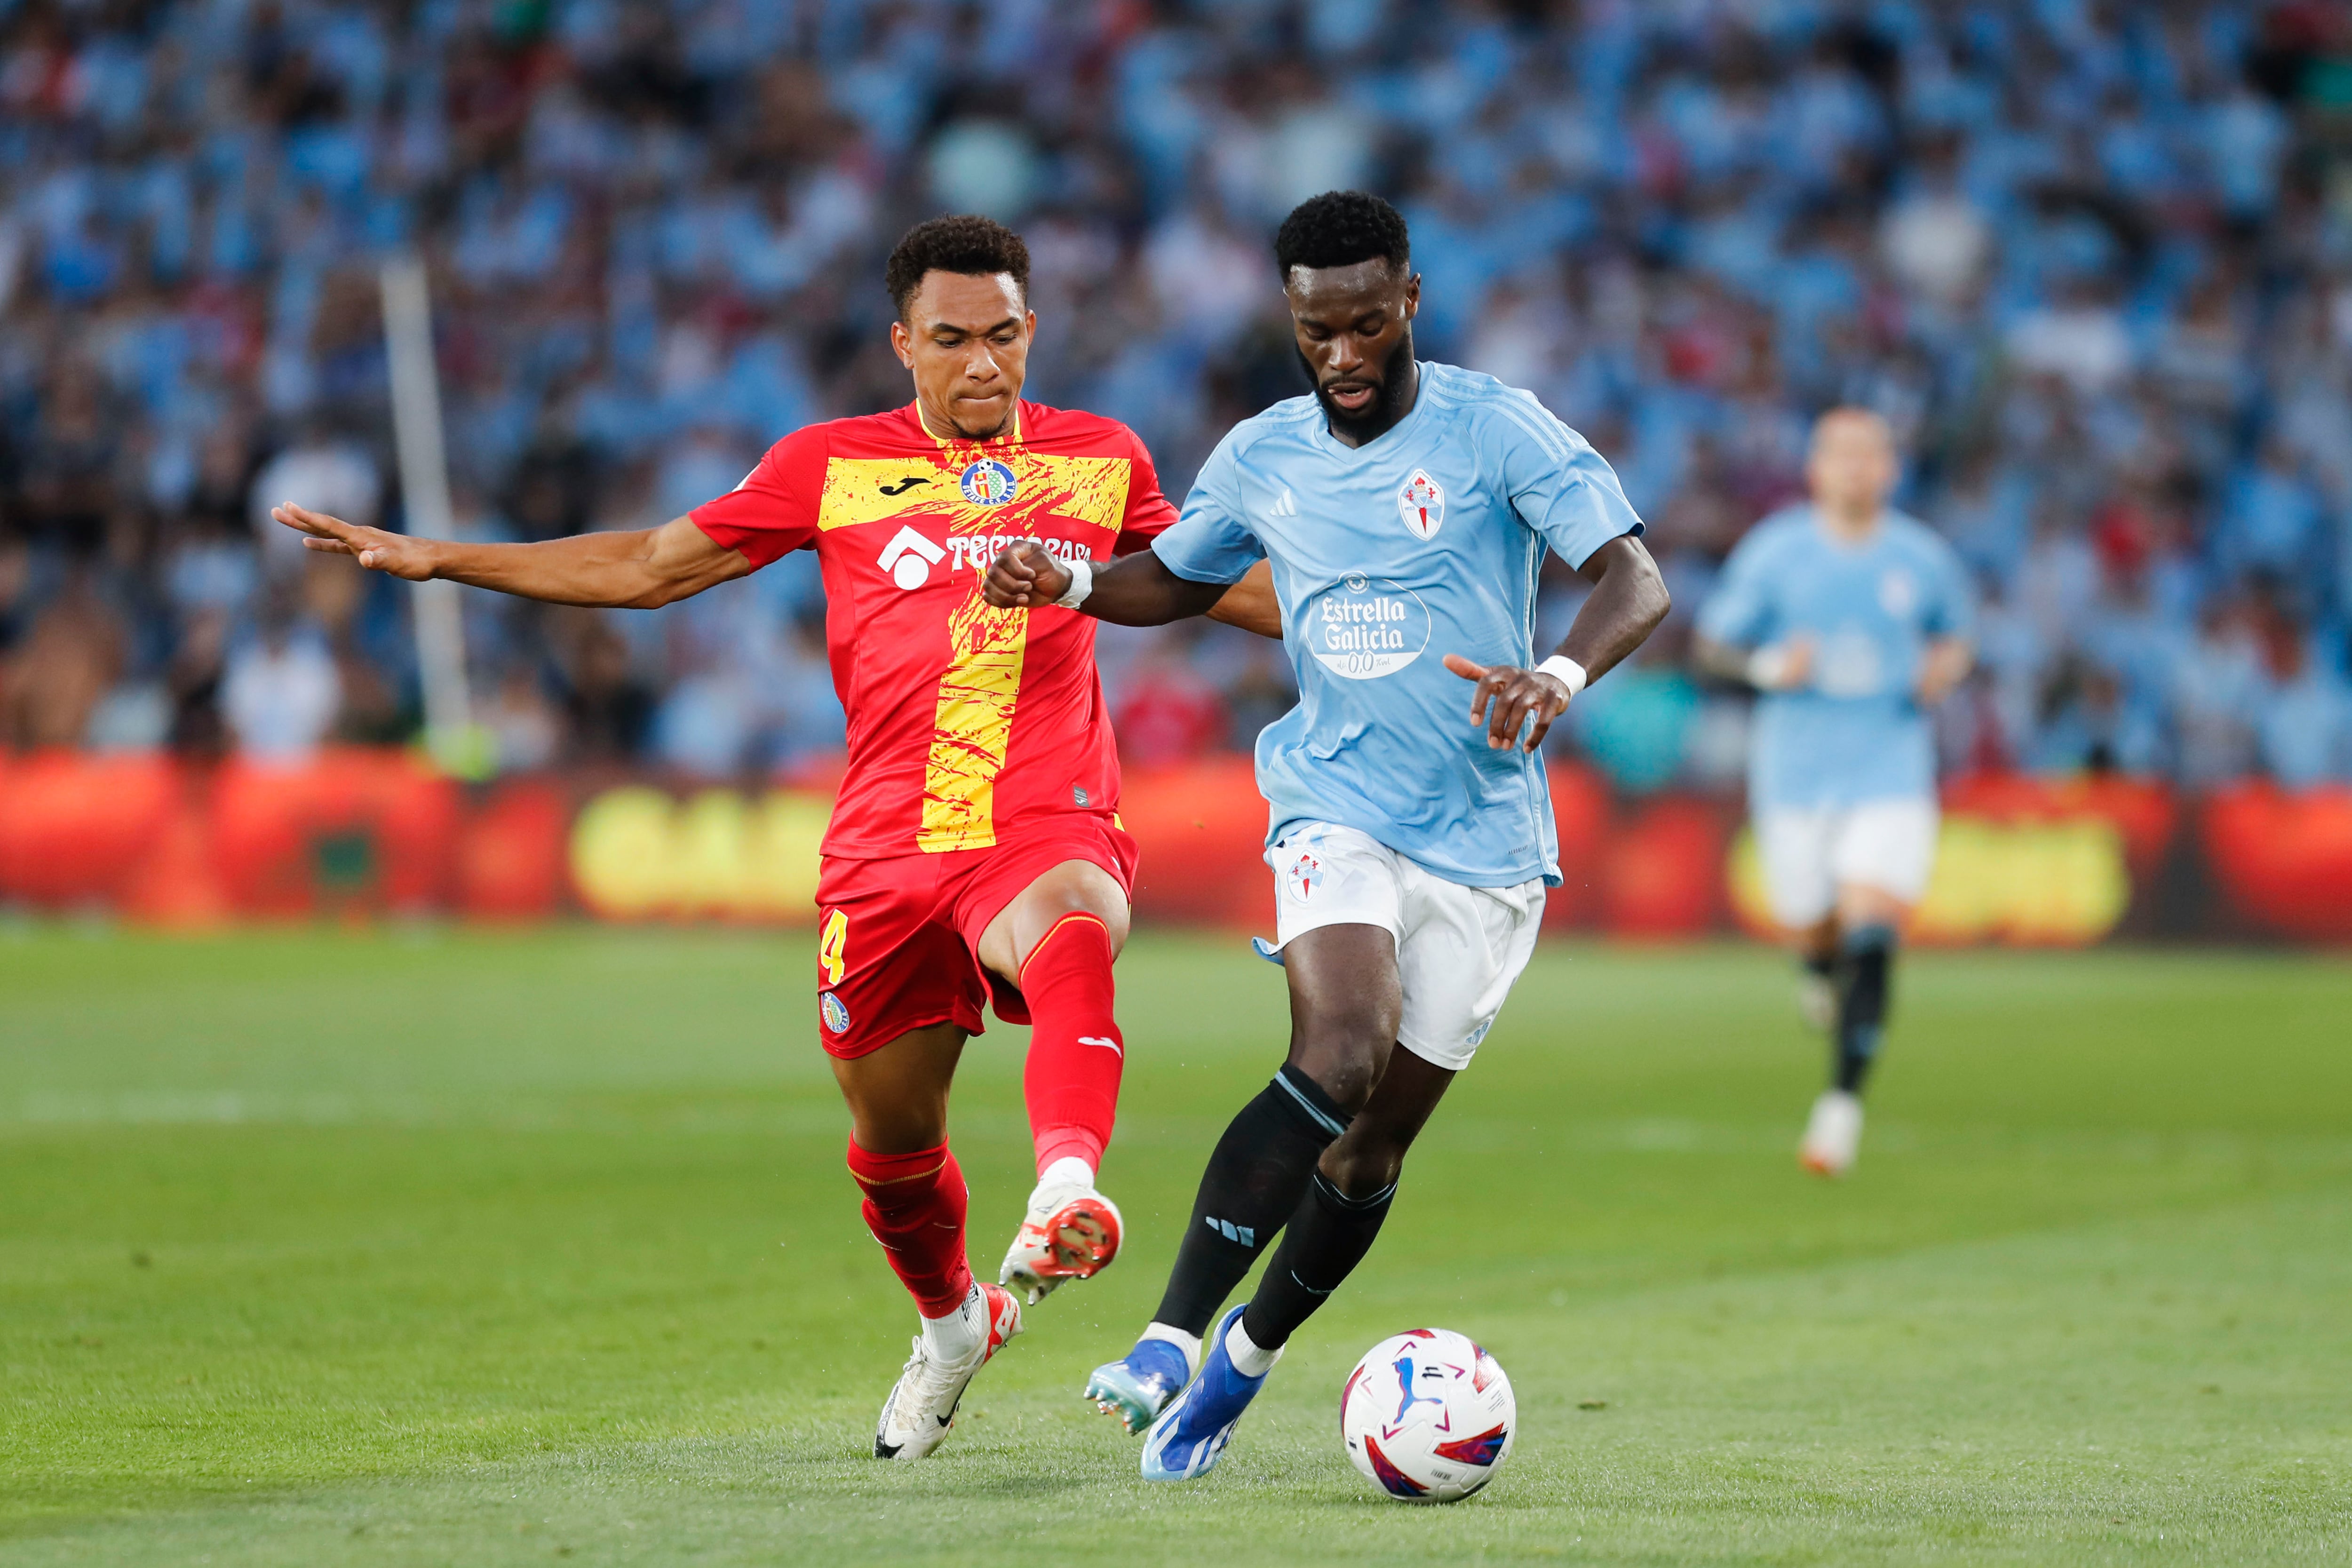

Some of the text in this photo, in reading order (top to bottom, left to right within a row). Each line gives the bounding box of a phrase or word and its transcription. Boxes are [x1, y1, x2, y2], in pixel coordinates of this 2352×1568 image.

[962, 485, 985, 504] GETAFE
[946, 535, 1091, 570] TECCASA
[1321, 597, 1406, 623] Estrella
[1325, 623, 1405, 651] Galicia
[1348, 652, 1374, 674] 0,0
[820, 908, 849, 987] 4
